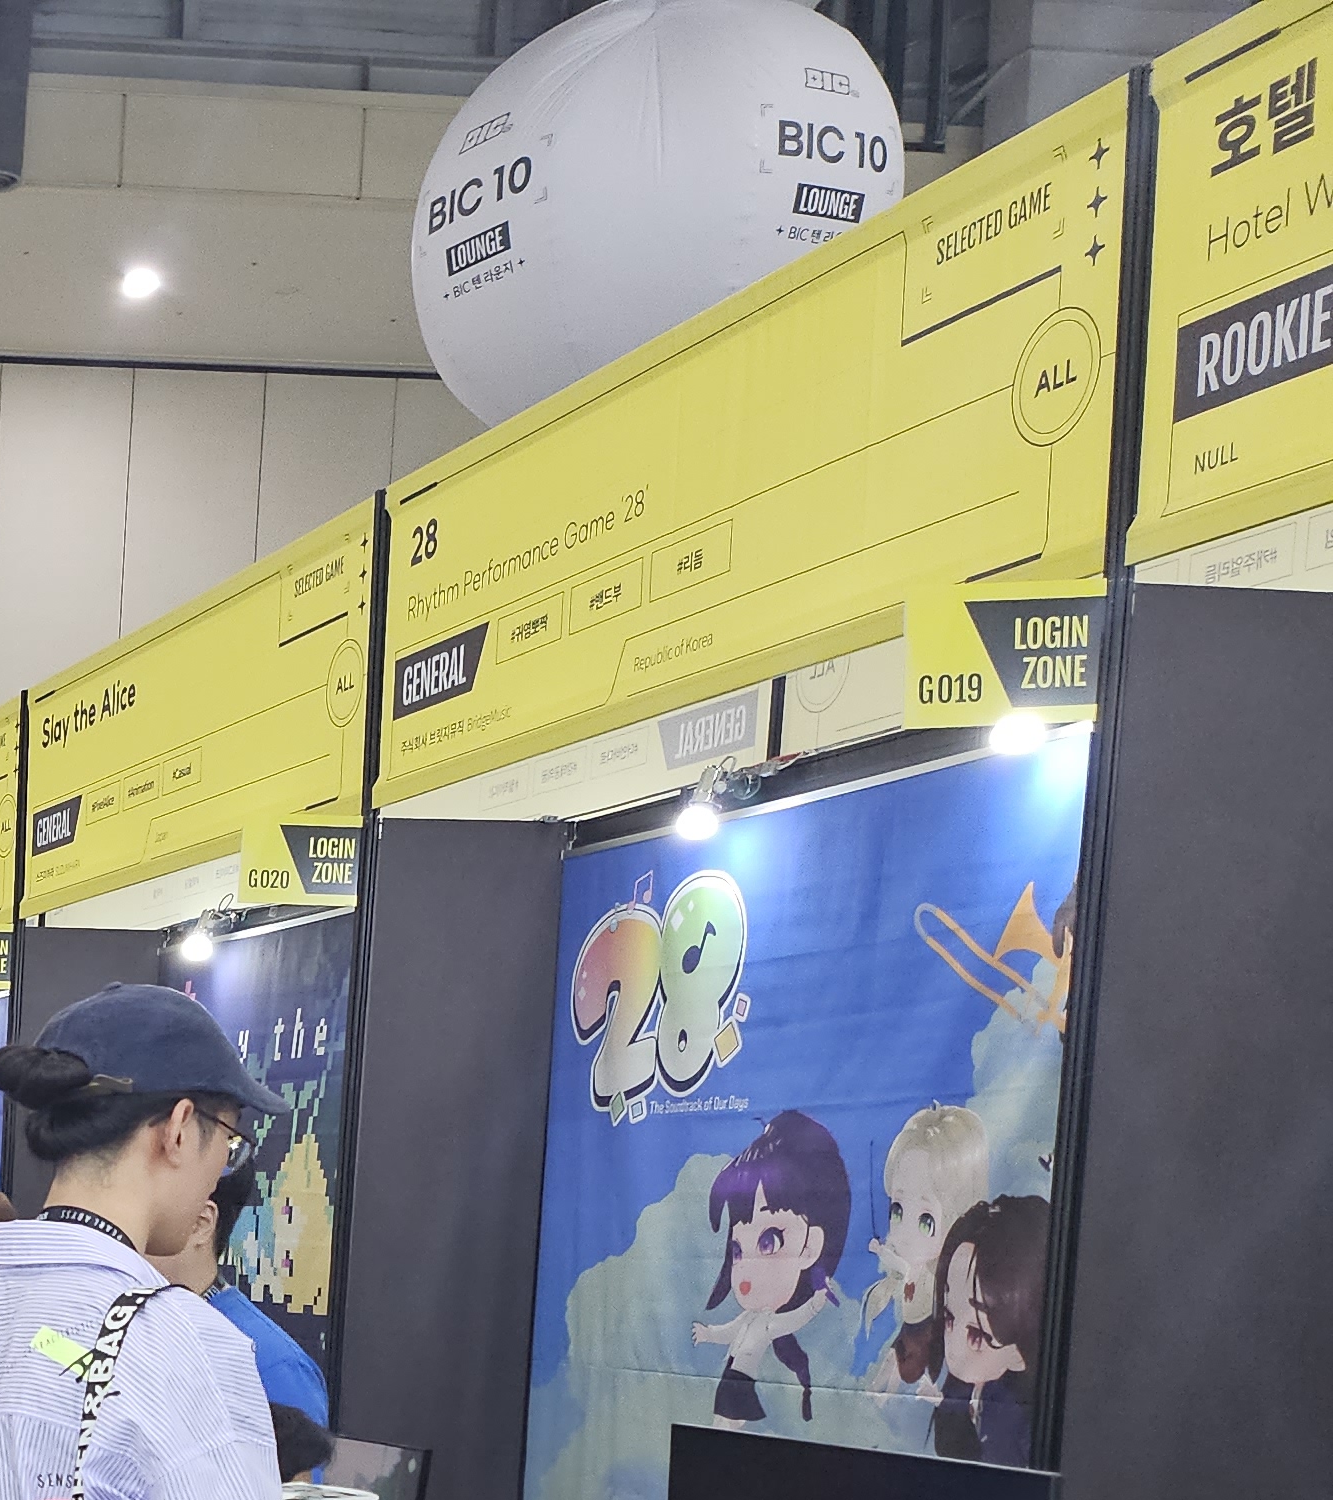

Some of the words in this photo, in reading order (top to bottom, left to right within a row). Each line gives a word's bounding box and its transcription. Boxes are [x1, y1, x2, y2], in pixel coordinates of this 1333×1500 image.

[1210, 56, 1318, 178] 호텔
[778, 119, 845, 163] BIC
[854, 131, 887, 173] 10
[428, 177, 483, 236] BIC
[493, 156, 532, 195] 10
[798, 187, 860, 221] LOUNGE
[788, 227, 809, 242] BIC
[810, 228, 822, 245] 텐
[935, 208, 1003, 267] SELECTED
[1007, 180, 1052, 231] GAME
[1206, 187, 1291, 262] Hotel
[451, 226, 509, 274] LOUNGE
[453, 281, 471, 298] BIC
[484, 262, 514, 285] 라운지
[1197, 283, 1333, 399] ROOKIE
[1035, 356, 1078, 397] ALL
[1193, 440, 1239, 476] NULL
[410, 517, 439, 567] 28
[677, 548, 704, 575] #리듬
[293, 567, 324, 599] SELECTED
[325, 555, 345, 583] GAME
[407, 583, 459, 622] Rhythm
[463, 535, 559, 596] Performance
[564, 510, 615, 550] Game
[633, 650, 672, 672] Republic
[673, 645, 685, 660] of
[685, 631, 713, 655] Korea
[1013, 613, 1089, 651] LOGIN
[335, 680, 355, 696] ALL
[402, 643, 467, 706] GENERAL
[918, 670, 983, 705] G019
[1020, 652, 1088, 691] ZONE
[41, 715, 71, 748] Slay
[73, 699, 96, 731] the
[99, 679, 137, 721] Alice
[1, 820, 12, 834] ALL
[35, 807, 72, 849] GENERAL
[308, 836, 356, 860] LOGIN
[248, 868, 290, 890] G020
[311, 861, 353, 884] ZONE
[572, 870, 747, 1110] 28
[273, 1007, 328, 1062] the
[649, 1100, 664, 1114] The
[665, 1097, 703, 1114] Soundtrack
[703, 1096, 713, 1111] of
[714, 1096, 728, 1110] Our
[729, 1095, 750, 1112] Days
[94, 1216, 124, 1241] PEARL
